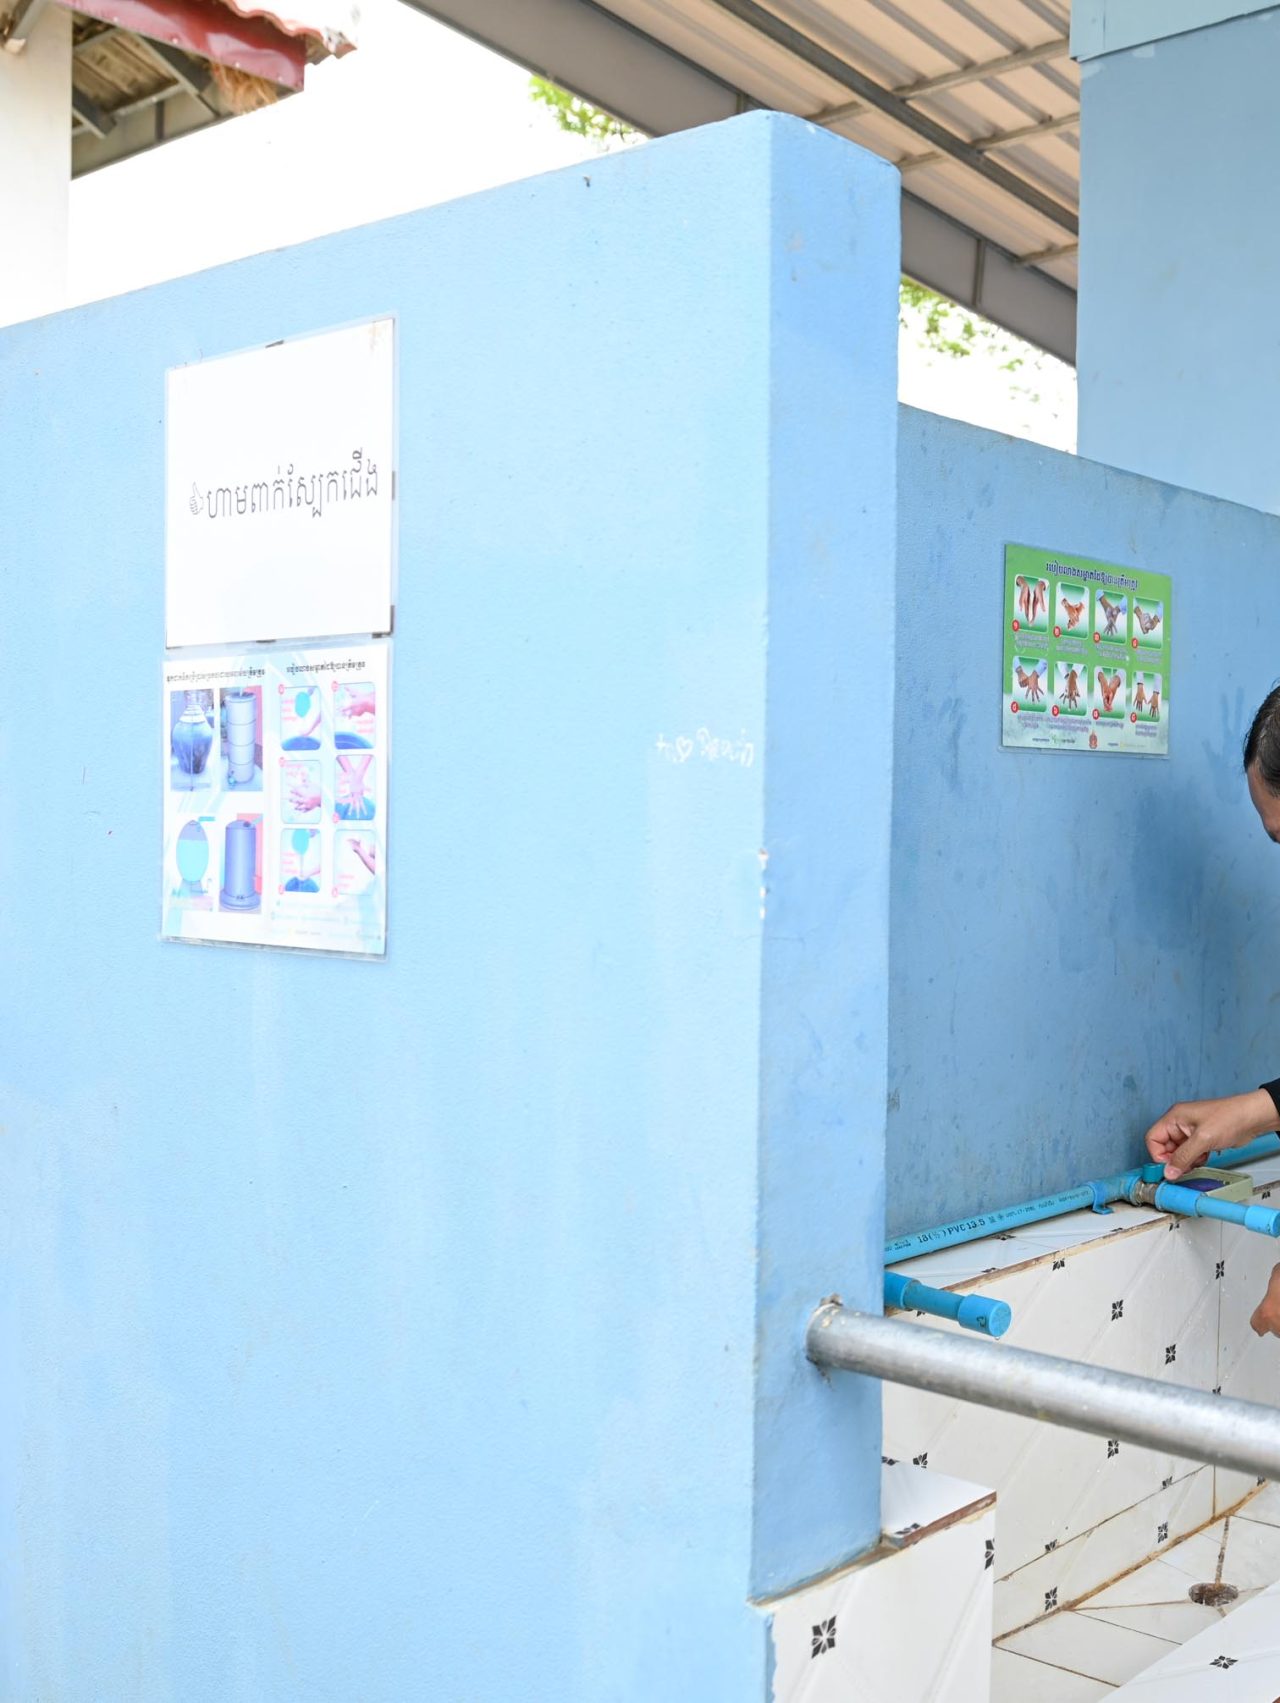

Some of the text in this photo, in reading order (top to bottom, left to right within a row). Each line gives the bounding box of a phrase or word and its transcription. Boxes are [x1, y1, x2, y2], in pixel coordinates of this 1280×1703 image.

[206, 447, 379, 519] ហាមពាក់ស្បែកជើង
[948, 1224, 966, 1236] PVC
